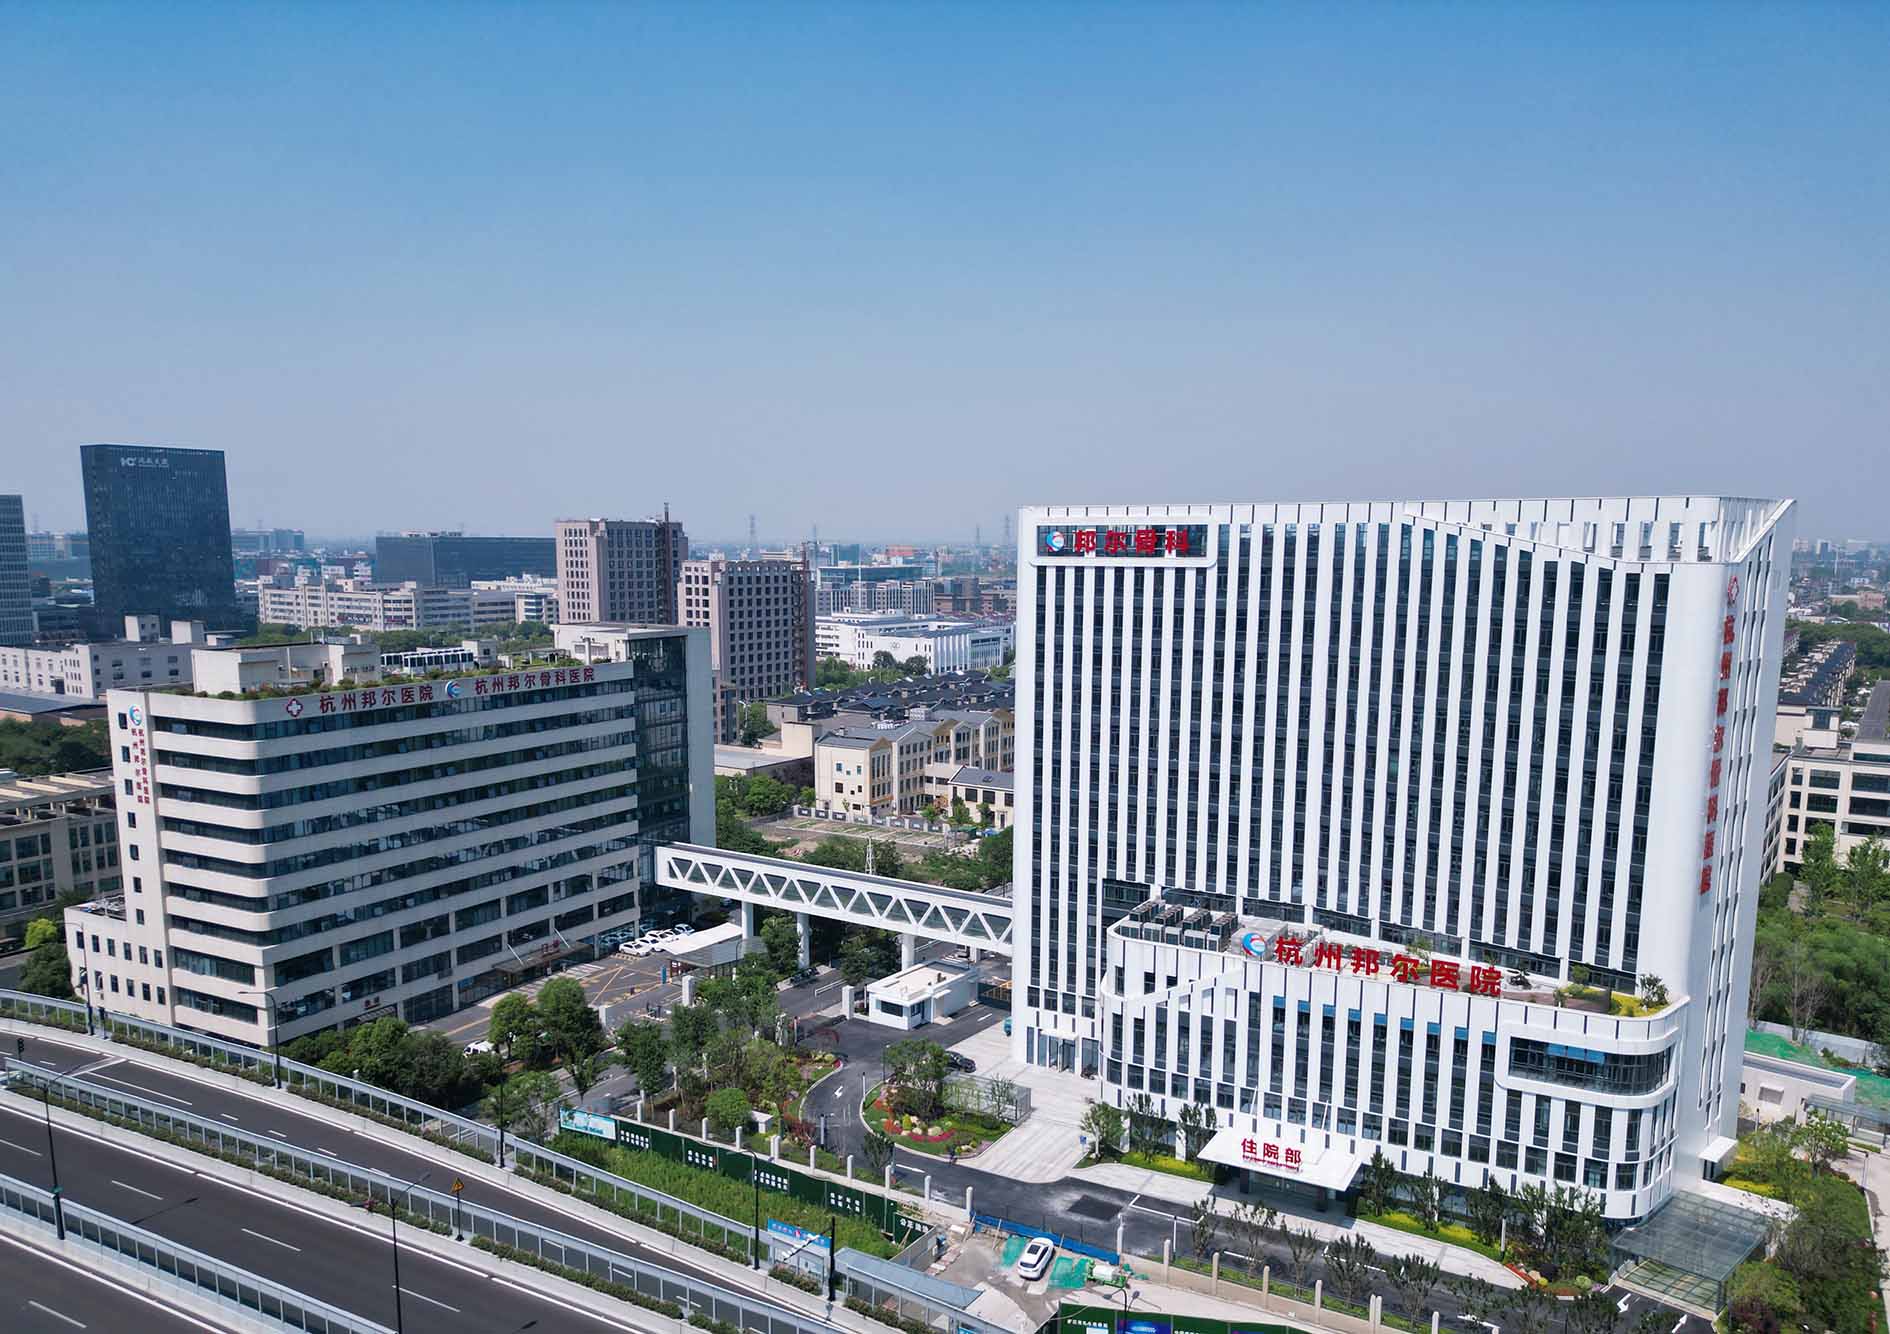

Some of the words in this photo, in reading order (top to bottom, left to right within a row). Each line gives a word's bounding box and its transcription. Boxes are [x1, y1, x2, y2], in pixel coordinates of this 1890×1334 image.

[1074, 528, 1189, 555] 邦尔骨科
[475, 666, 594, 694] 杭州邦尔骨科医院
[320, 684, 434, 713] 杭州邦尔医院
[1275, 935, 1502, 996] 杭州邦尔医院
[1241, 1138, 1301, 1164] 住院部
